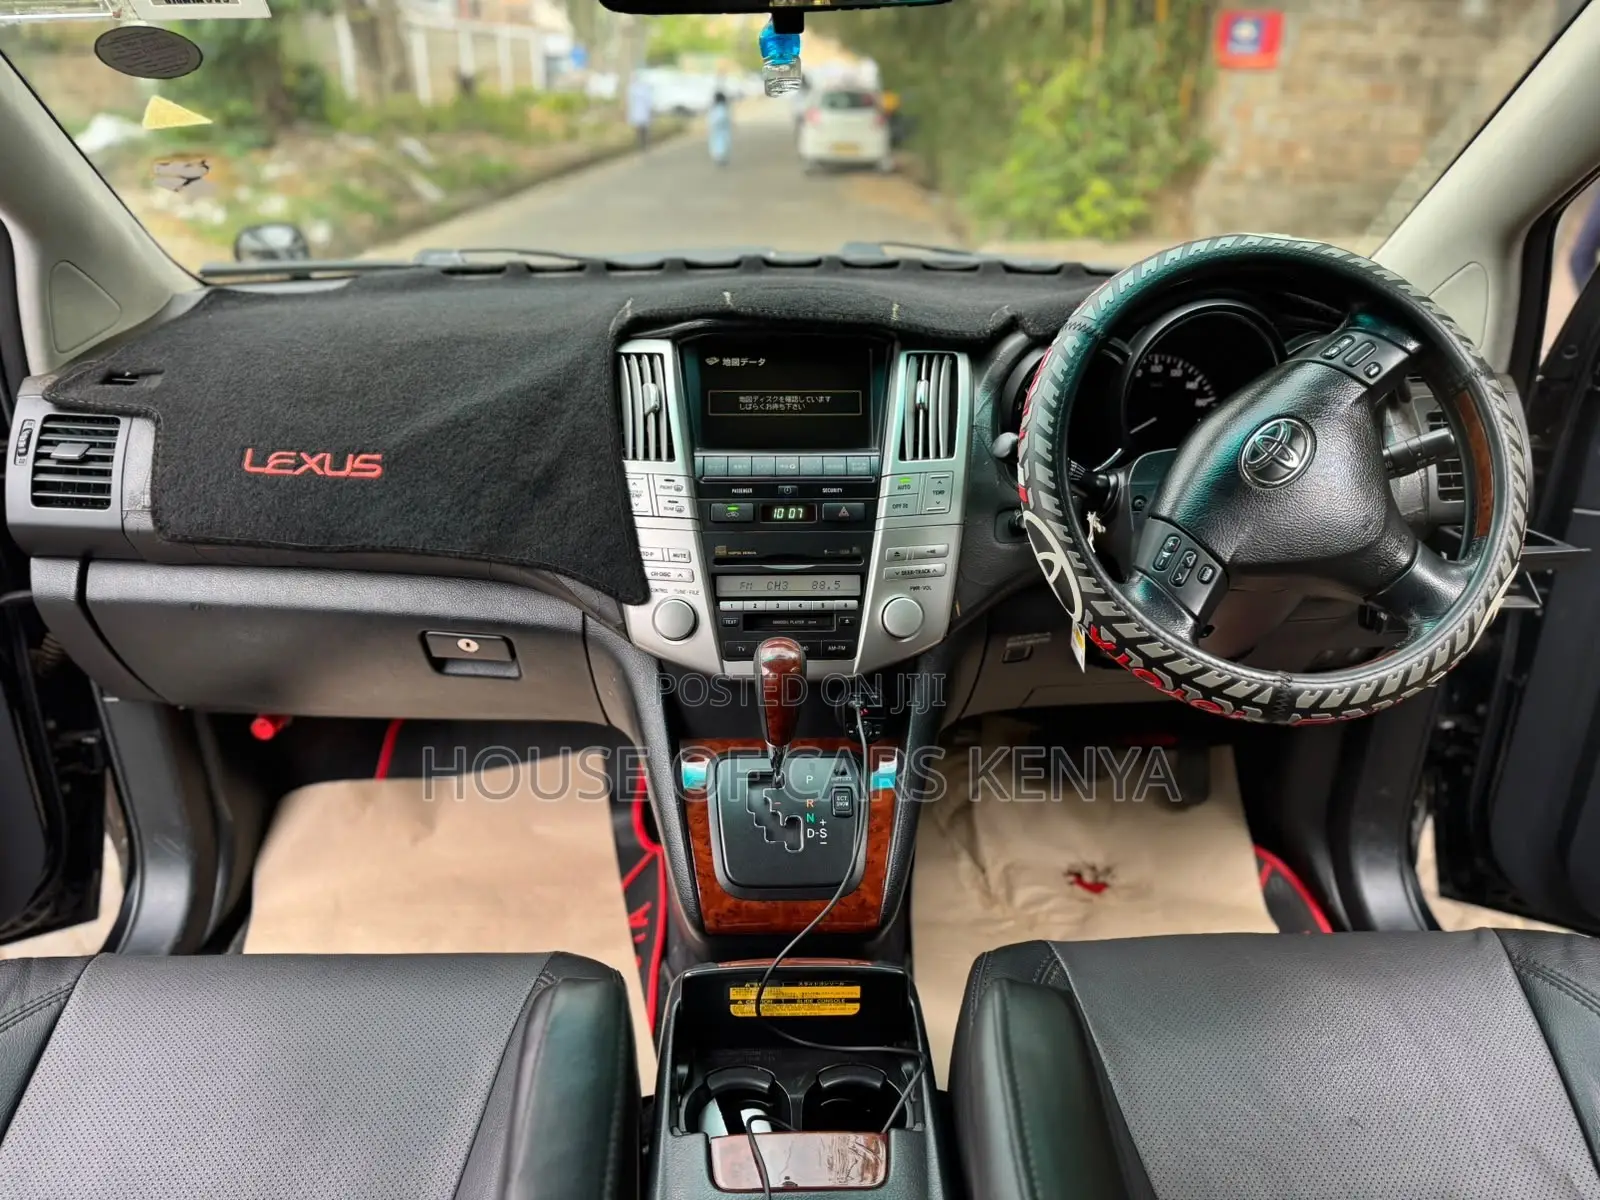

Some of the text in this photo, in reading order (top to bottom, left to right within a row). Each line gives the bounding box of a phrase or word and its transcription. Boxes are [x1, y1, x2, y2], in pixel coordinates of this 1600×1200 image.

[722, 357, 766, 367] 地図データ
[242, 448, 383, 478] LEXUS
[740, 579, 841, 591] FM CH3 88.5
[806, 775, 814, 784] P
[806, 799, 814, 808] R
[806, 813, 815, 823] N
